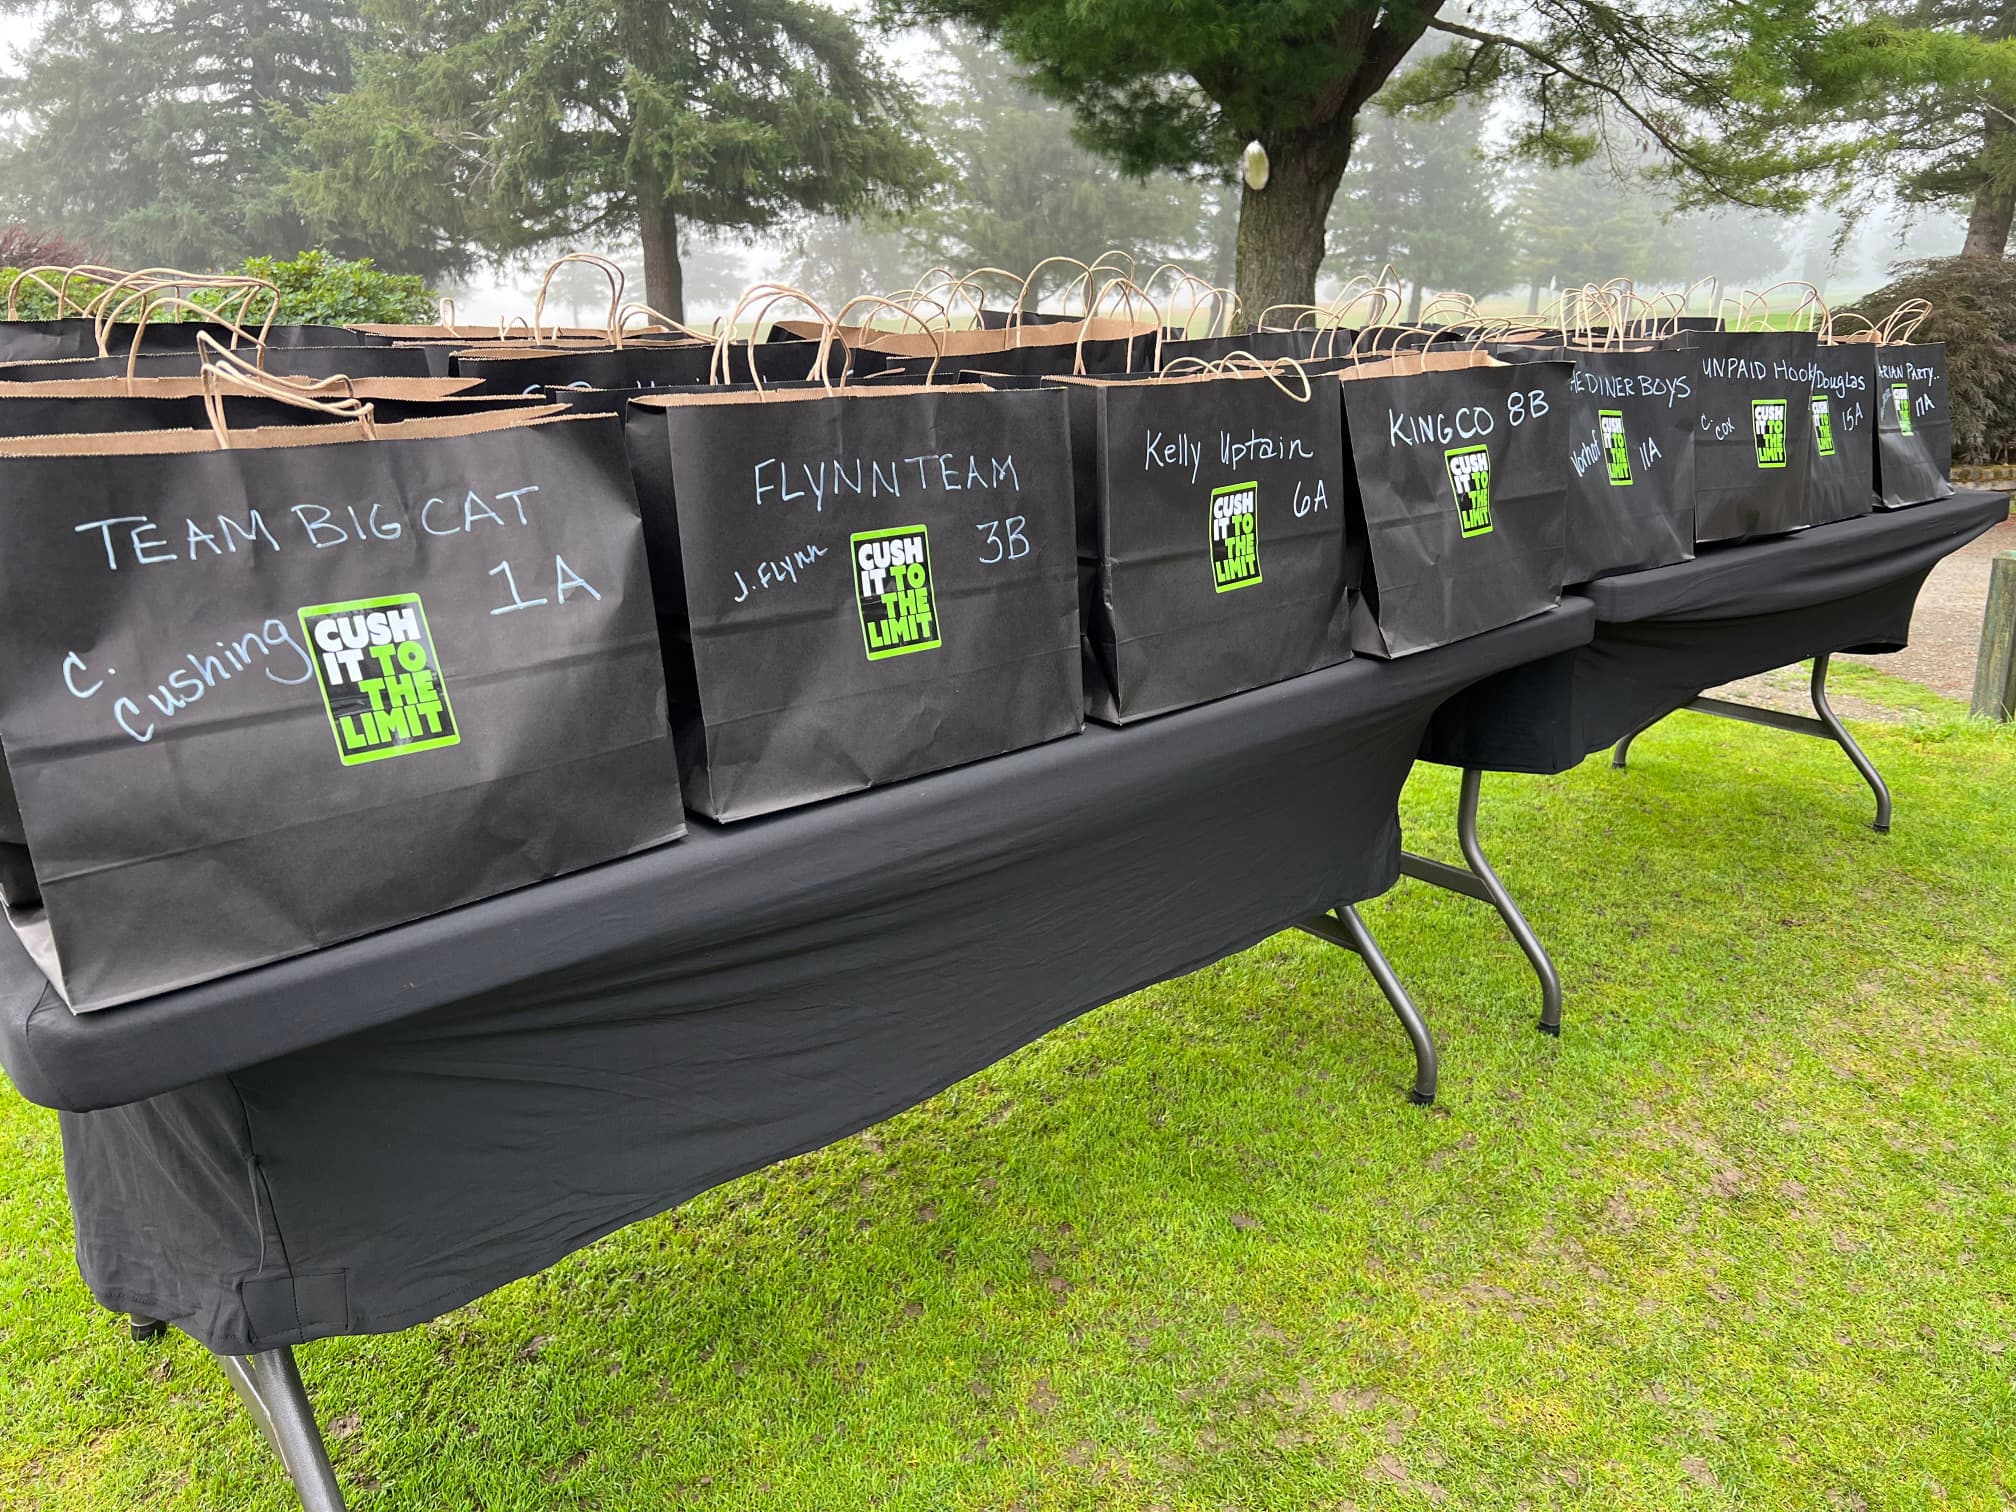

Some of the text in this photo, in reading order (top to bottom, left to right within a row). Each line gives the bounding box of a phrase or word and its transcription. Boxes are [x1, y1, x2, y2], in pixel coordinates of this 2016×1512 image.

[1702, 357, 1766, 380] UNPAID
[1585, 373, 1635, 398] DINER
[1638, 375, 1691, 408] BOYS
[1507, 389, 1549, 427] 8B
[1755, 405, 1784, 421] CUSH
[1842, 401, 1864, 431] 15A
[1601, 417, 1622, 433] CUSH
[1755, 420, 1784, 435] IT TO
[1603, 432, 1625, 449] IT TO
[1610, 447, 1627, 463] THE
[1639, 436, 1662, 471] 11A
[1758, 447, 1784, 461] LIMIT
[1763, 433, 1784, 448] THE
[1144, 429, 1313, 485] Kelly Uptain
[1450, 452, 1488, 476] CUSH
[1608, 462, 1629, 478] LIMIT
[754, 453, 1020, 512] FLYNN TEAM
[1454, 471, 1489, 494] IT TO
[1213, 491, 1254, 519] CUSH
[1293, 480, 1328, 518] 6A
[1468, 488, 1488, 509] THE
[75, 486, 539, 570] TEAM BIG CAT
[1213, 513, 1254, 541] IT TO
[1462, 507, 1489, 529] LIMIT
[858, 537, 924, 570] CUSH
[976, 515, 1031, 564] 3B
[1225, 533, 1255, 559] THE
[861, 563, 926, 597] IT TO
[1215, 554, 1255, 583] LIMIT
[489, 555, 602, 615] 1A
[881, 587, 931, 618] THE
[314, 607, 421, 652] CUSH
[867, 612, 932, 648] LIMIT
[322, 641, 427, 686] IT TO
[62, 619, 315, 742] C. Cushing
[358, 669, 439, 712] THE
[339, 700, 443, 749] LIMIT
